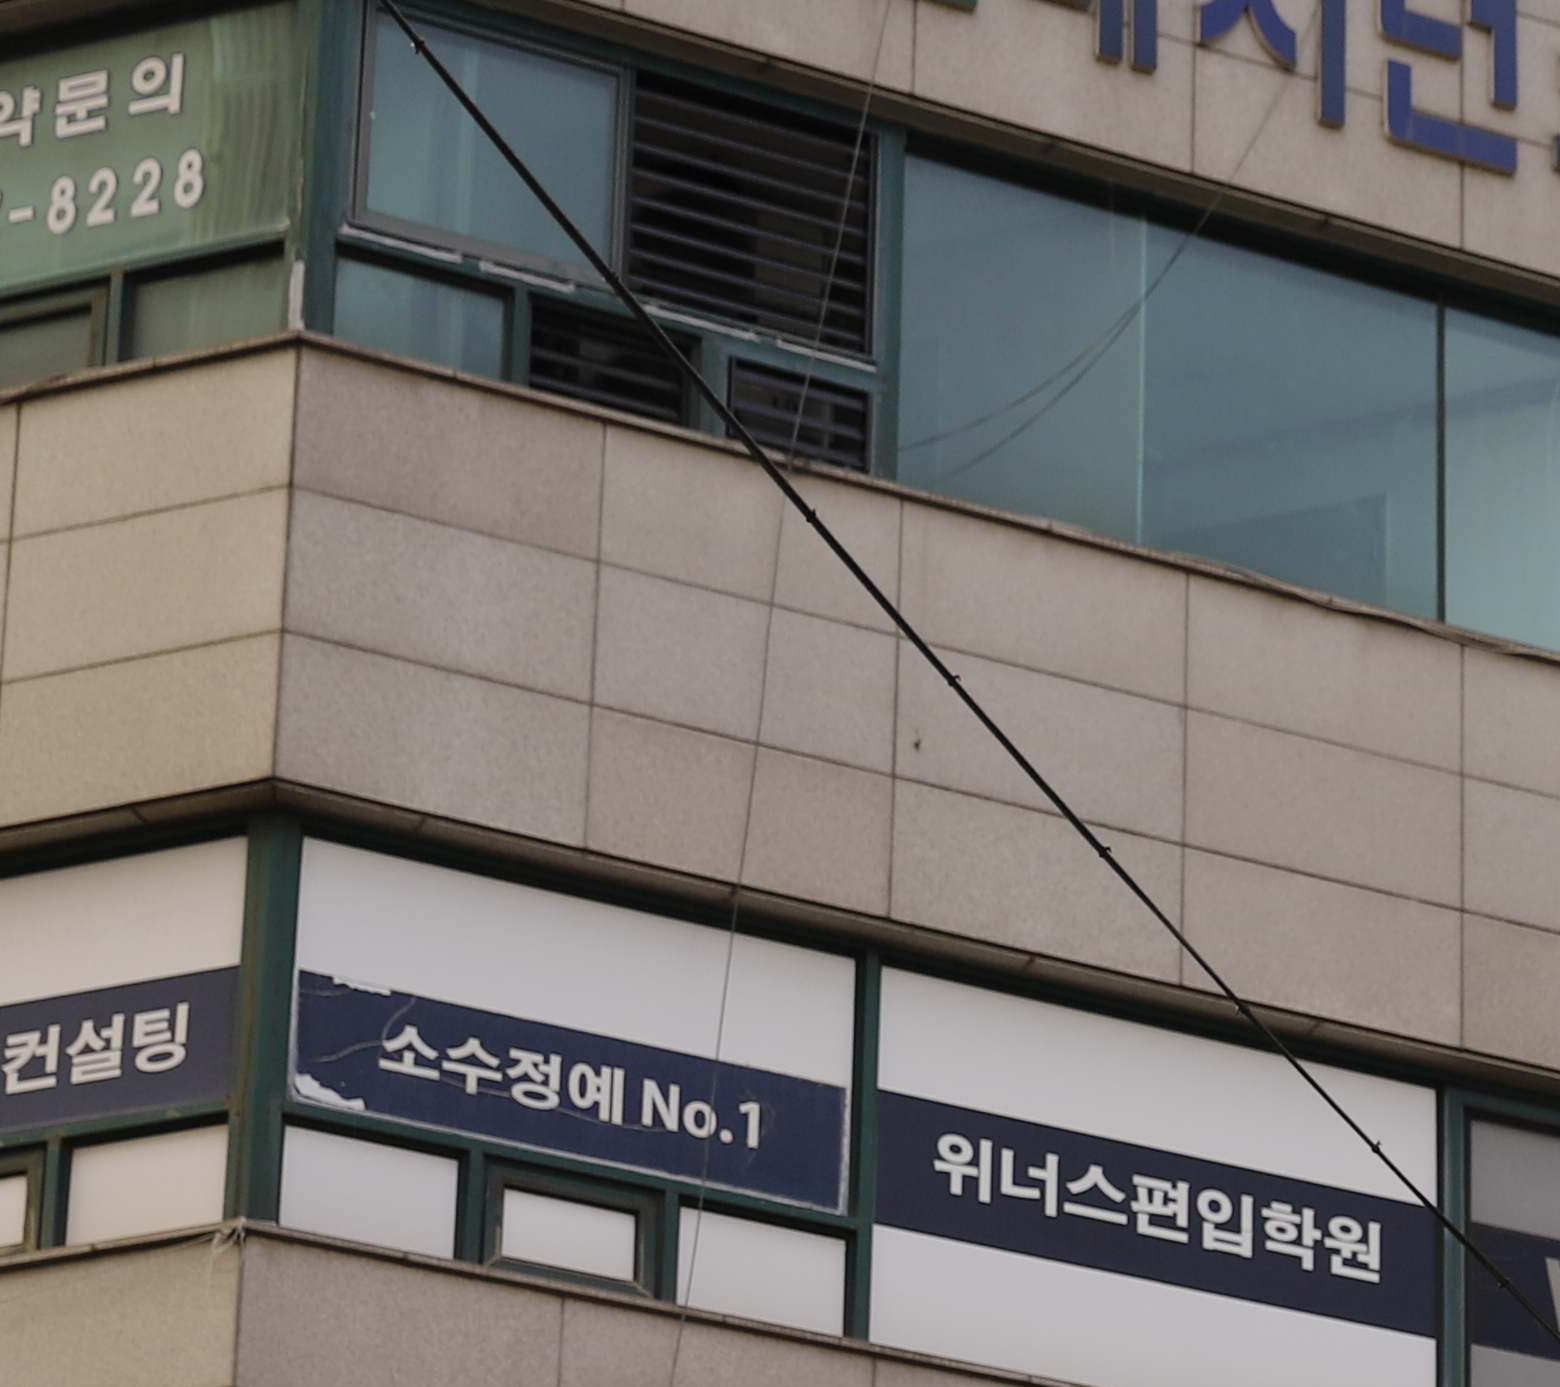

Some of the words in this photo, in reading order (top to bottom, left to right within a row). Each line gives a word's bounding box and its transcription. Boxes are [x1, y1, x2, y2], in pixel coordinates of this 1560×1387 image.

[378, 1024, 626, 1128] 소수정예
[640, 1074, 764, 1151] No.1
[932, 1132, 1385, 1285] 위너스편입학원
